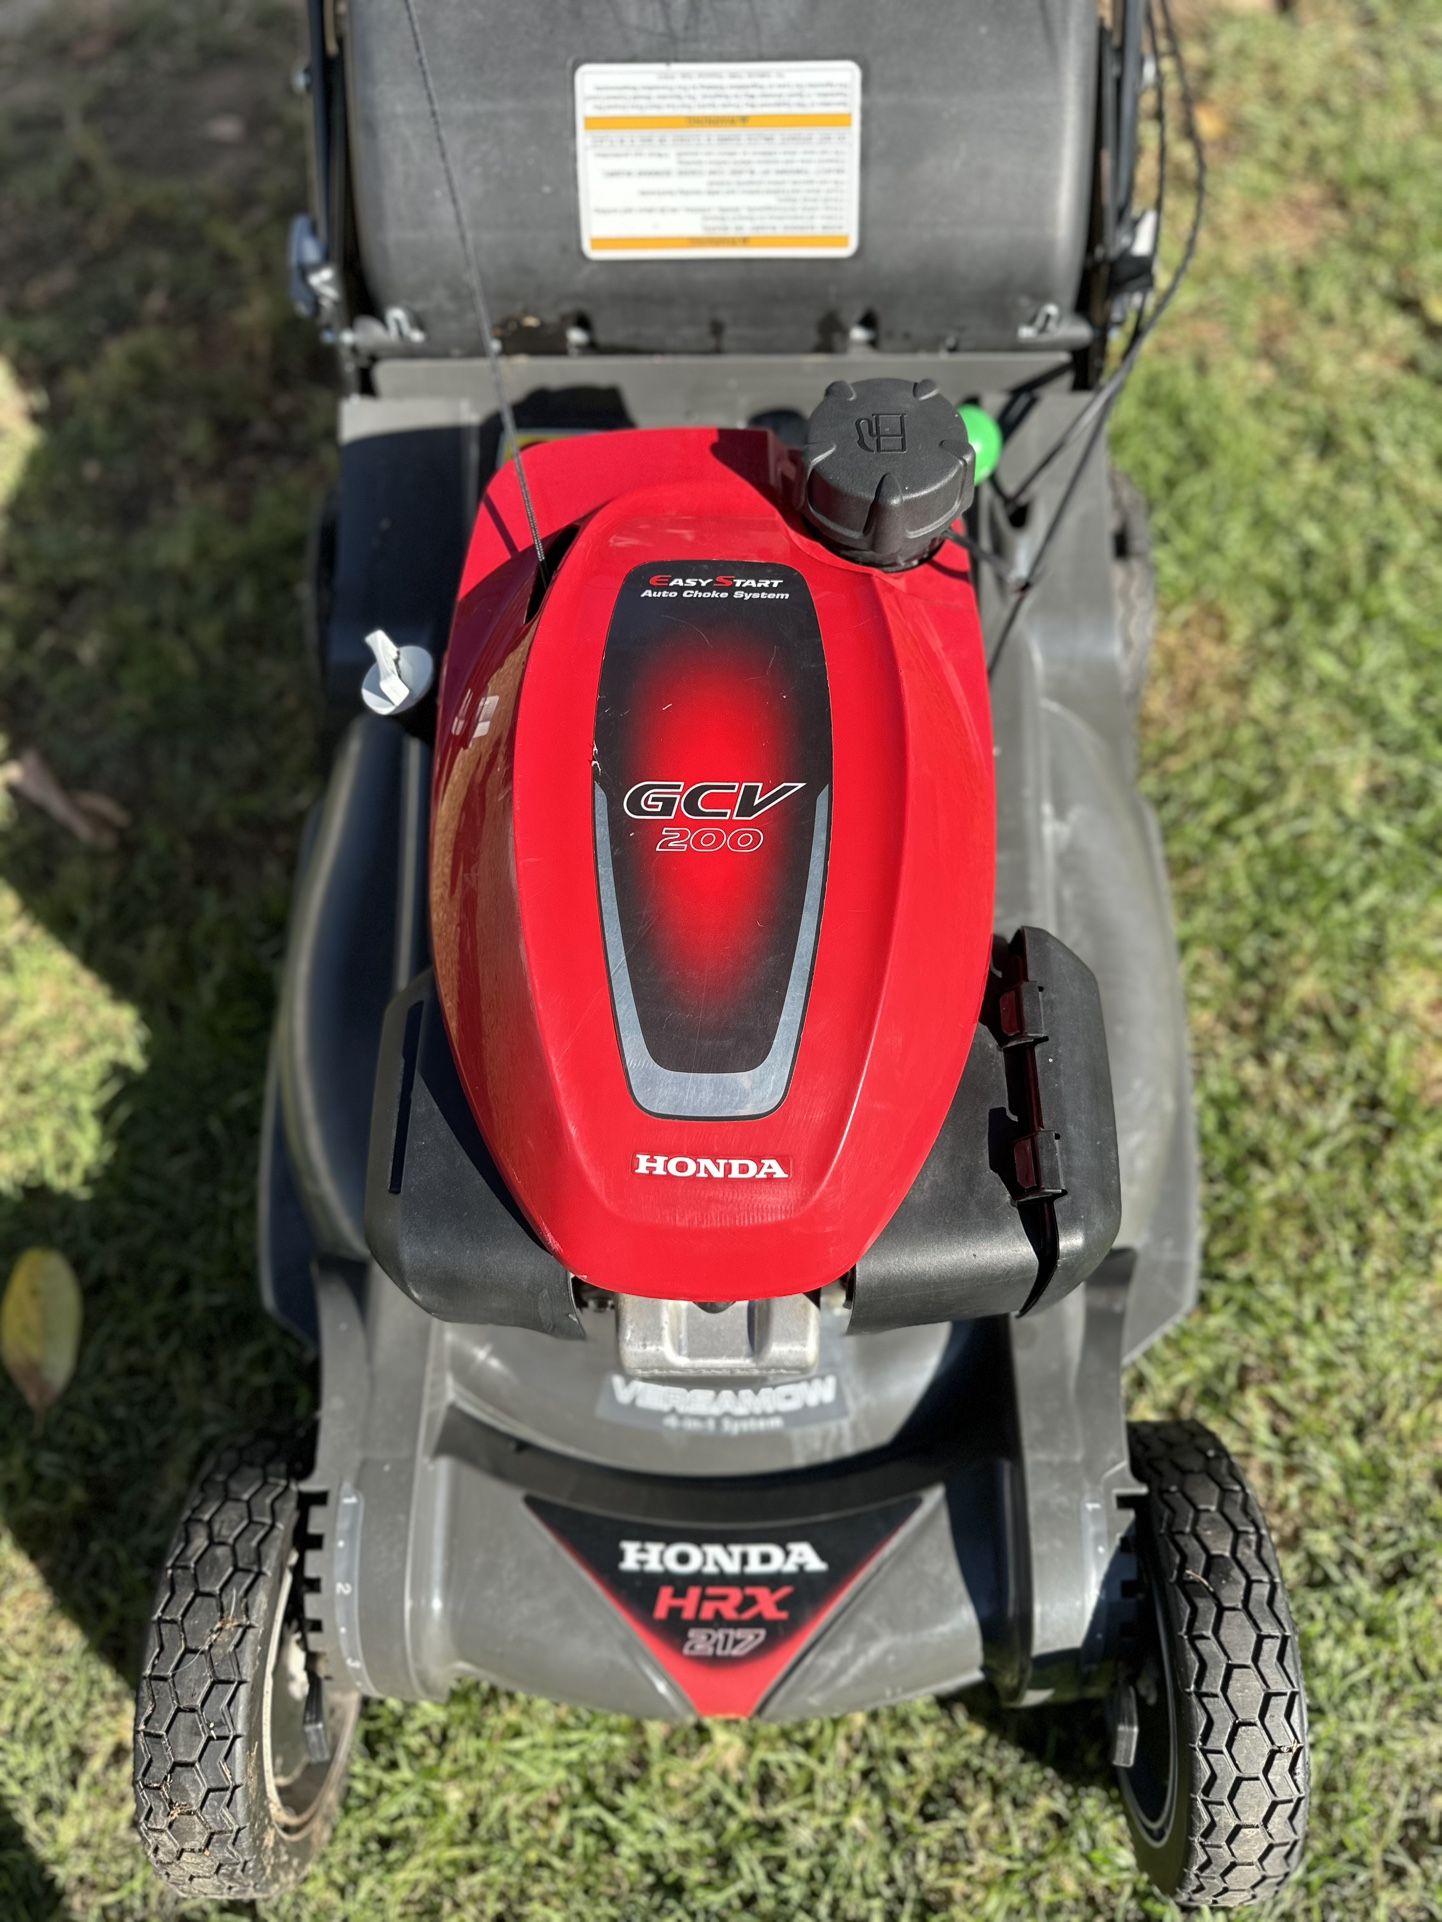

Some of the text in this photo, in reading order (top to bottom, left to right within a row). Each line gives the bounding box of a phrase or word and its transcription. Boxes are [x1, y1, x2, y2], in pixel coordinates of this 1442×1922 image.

[640, 589, 790, 600] Auto Choke System
[623, 781, 807, 820] GCV
[655, 827, 764, 852] 200
[635, 1154, 789, 1179] HONDA
[618, 1540, 829, 1575] HONDA
[653, 1586, 795, 1621] HRX
[682, 1627, 767, 1657] 217
